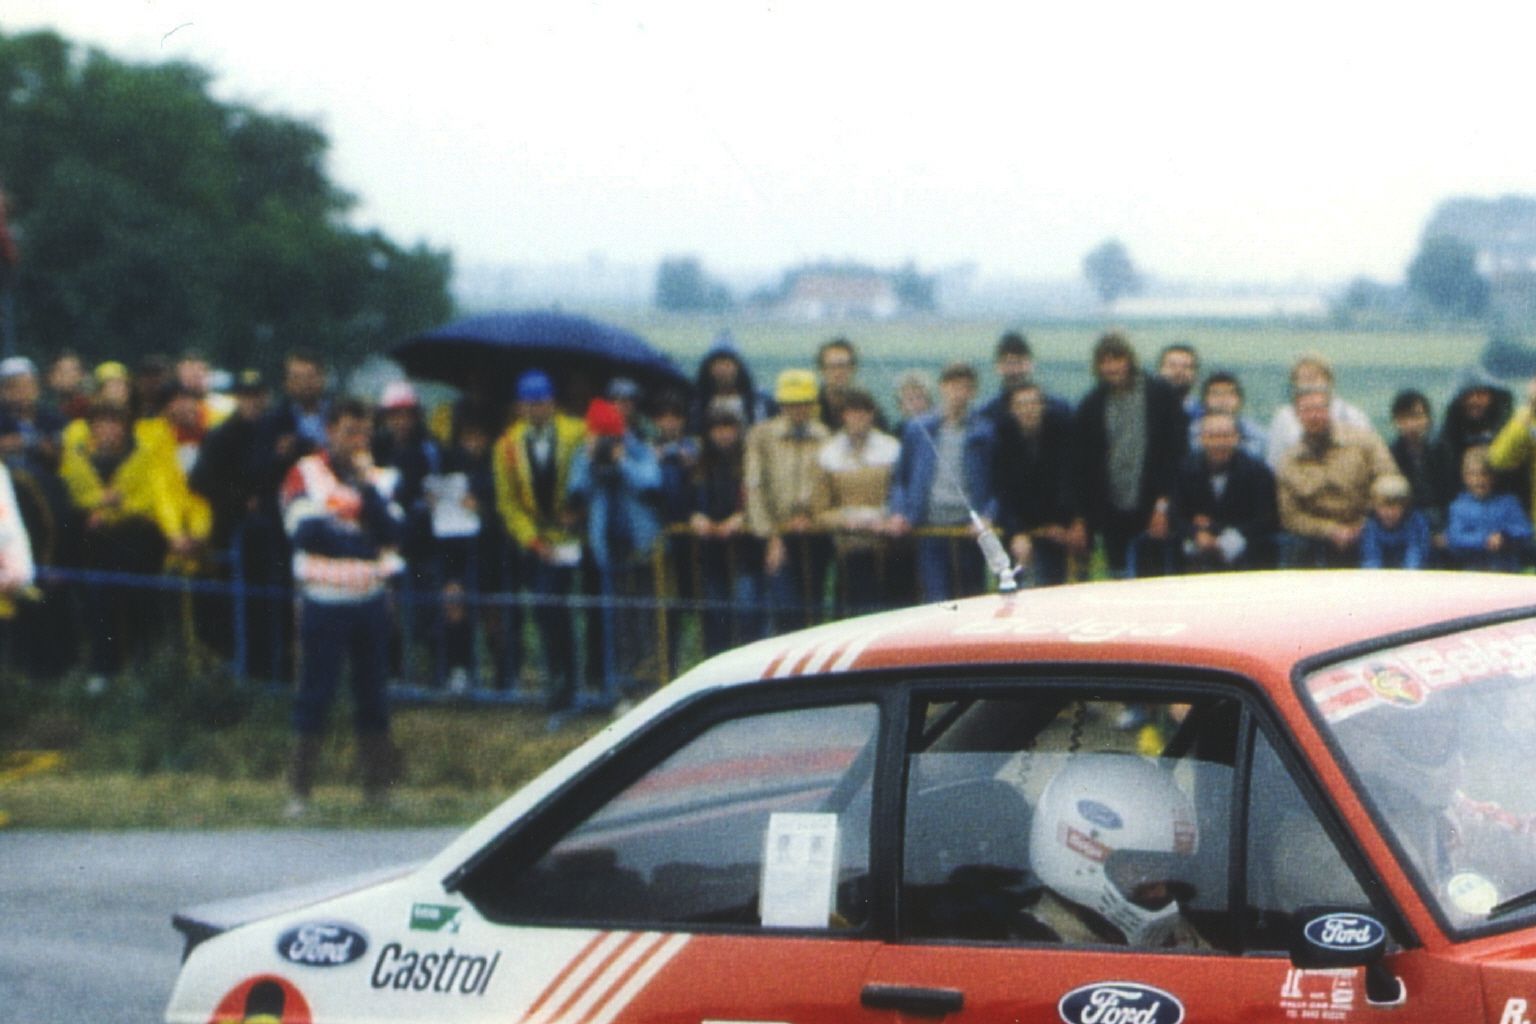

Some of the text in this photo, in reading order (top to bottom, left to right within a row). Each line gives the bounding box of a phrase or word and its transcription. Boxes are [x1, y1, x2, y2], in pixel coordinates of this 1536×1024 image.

[287, 924, 355, 963] Ford
[1320, 917, 1372, 944] Ford
[370, 942, 501, 996] Castrol
